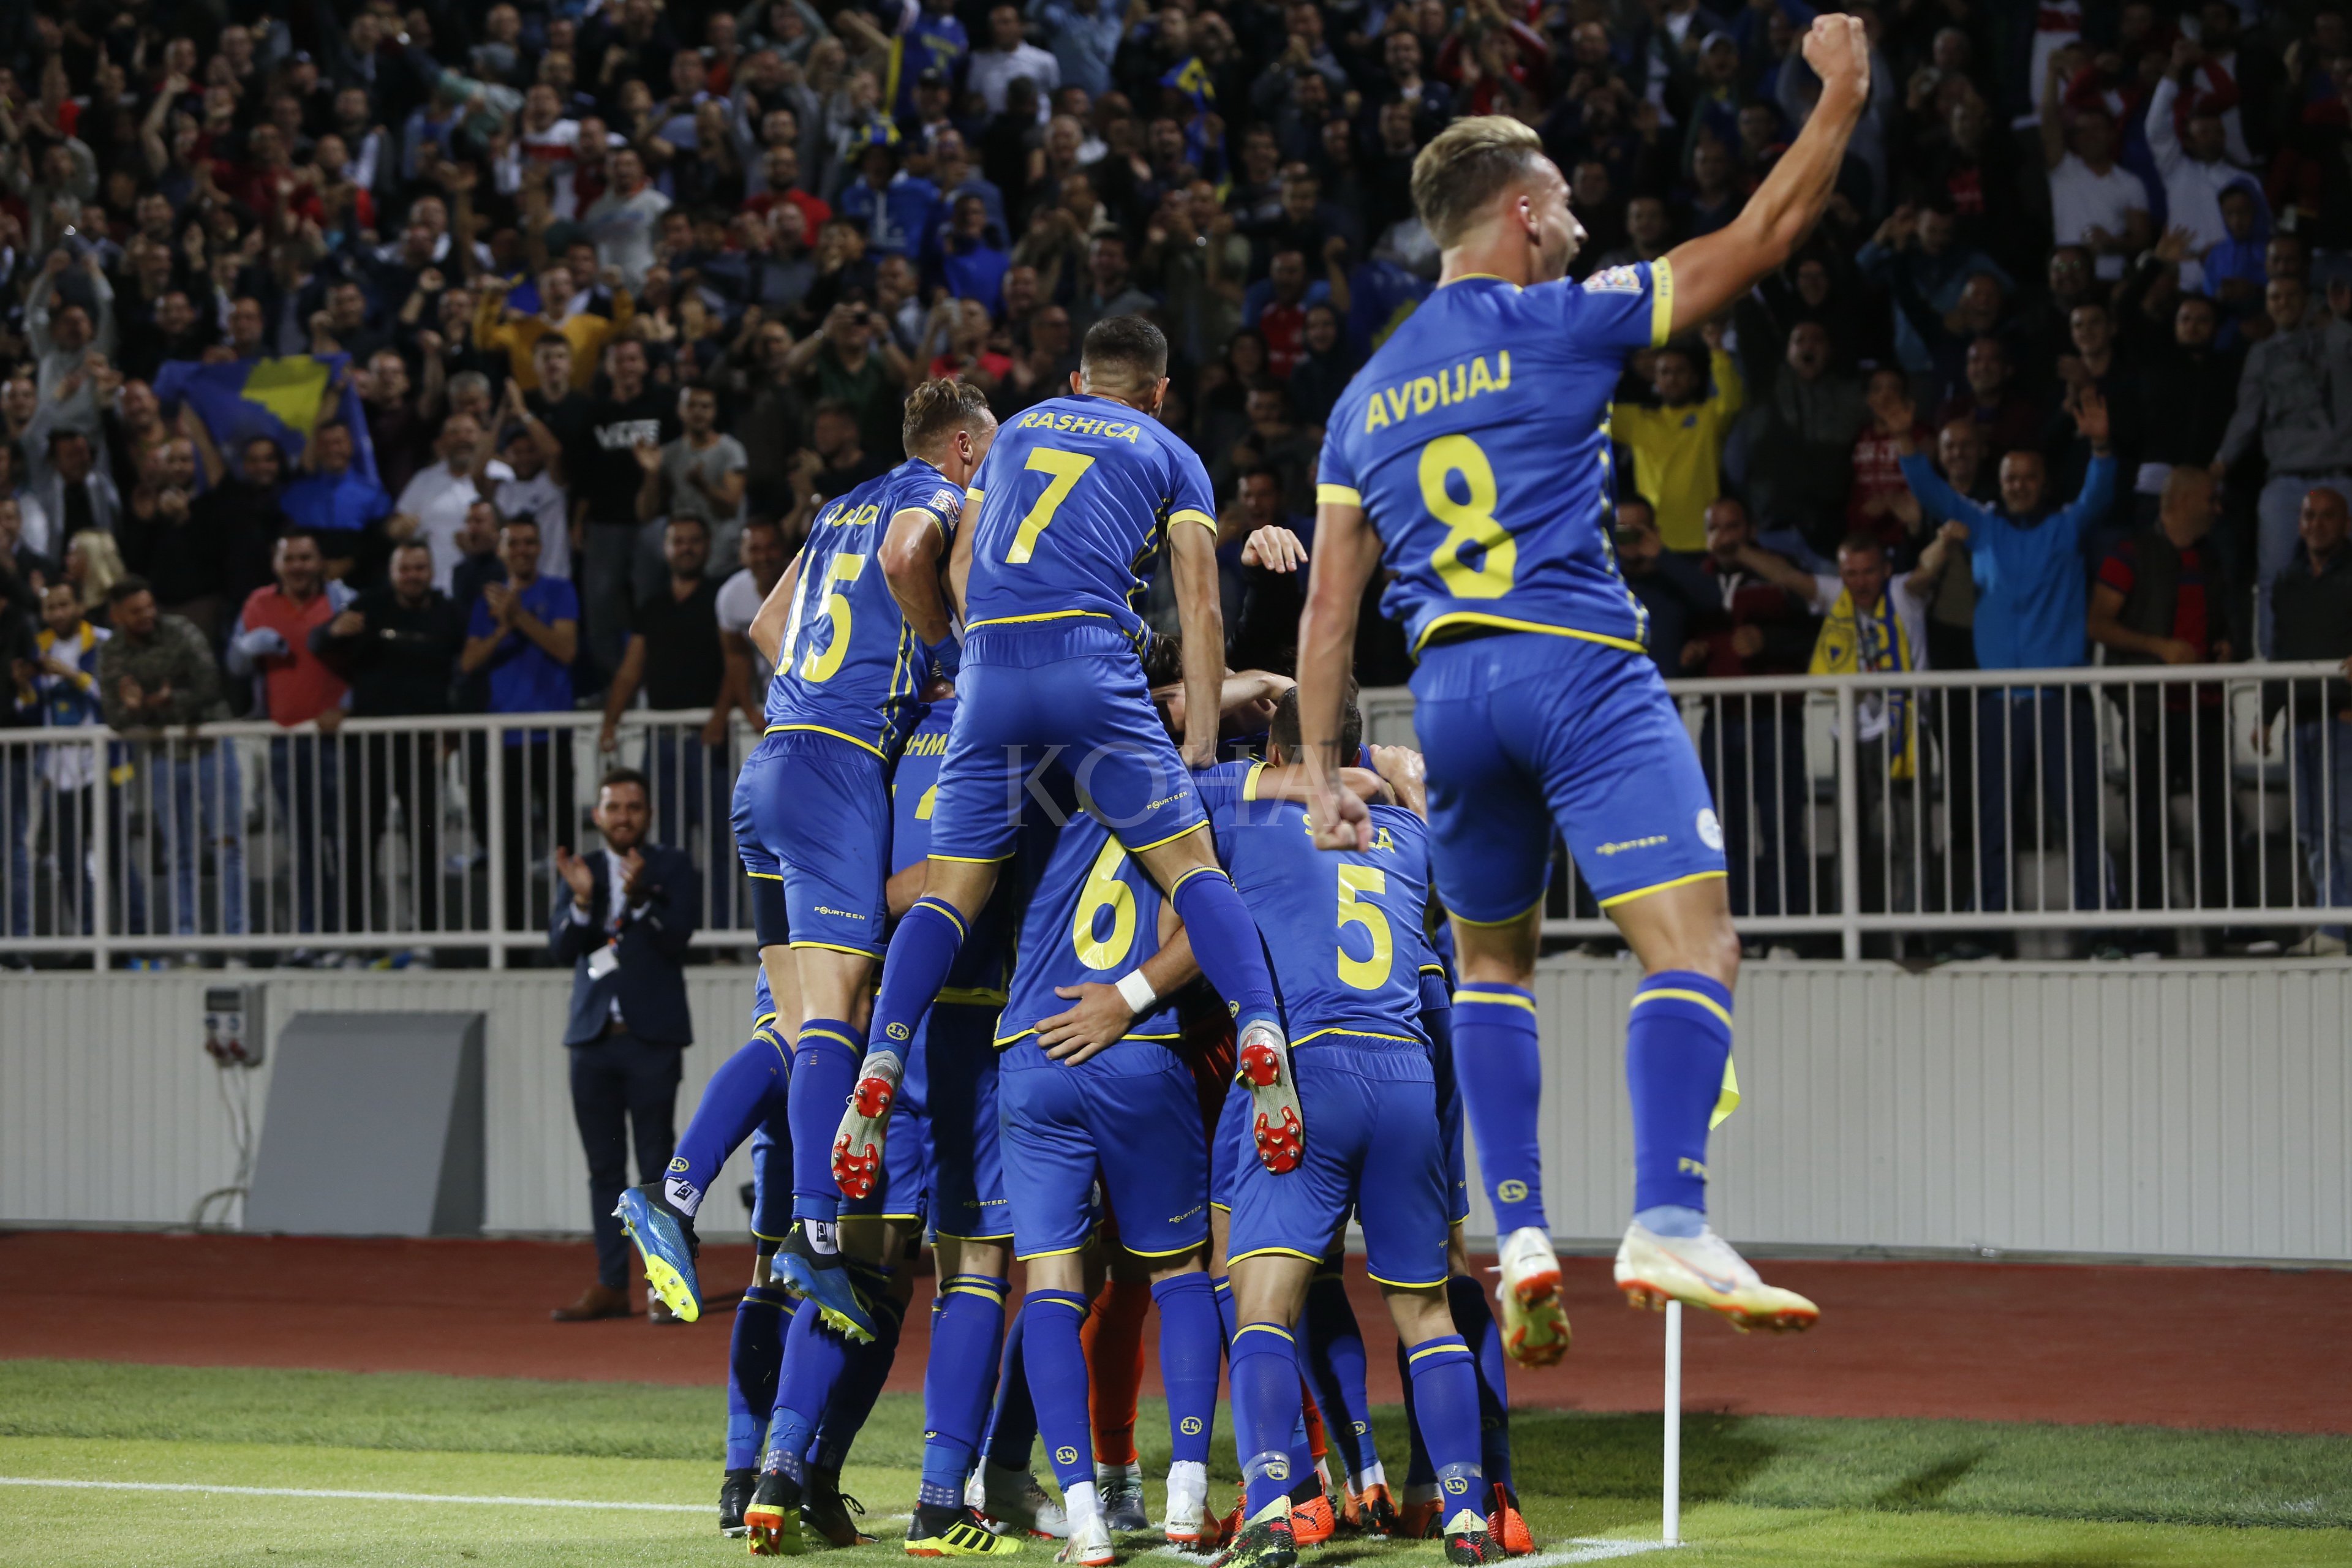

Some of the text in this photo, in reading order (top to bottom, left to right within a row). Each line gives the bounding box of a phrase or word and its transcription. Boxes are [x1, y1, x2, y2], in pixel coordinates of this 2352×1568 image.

[1017, 412, 1140, 444] RASHICA
[1365, 350, 1511, 434] AVDIJAJ
[1005, 447, 1096, 564] 7
[1417, 433, 1517, 599] 8
[774, 549, 866, 683] 15
[1147, 791, 1188, 810] FOURTEEN
[814, 906, 866, 921] FOURTEEN
[1072, 834, 1137, 971] 6
[1336, 862, 1393, 991] 5
